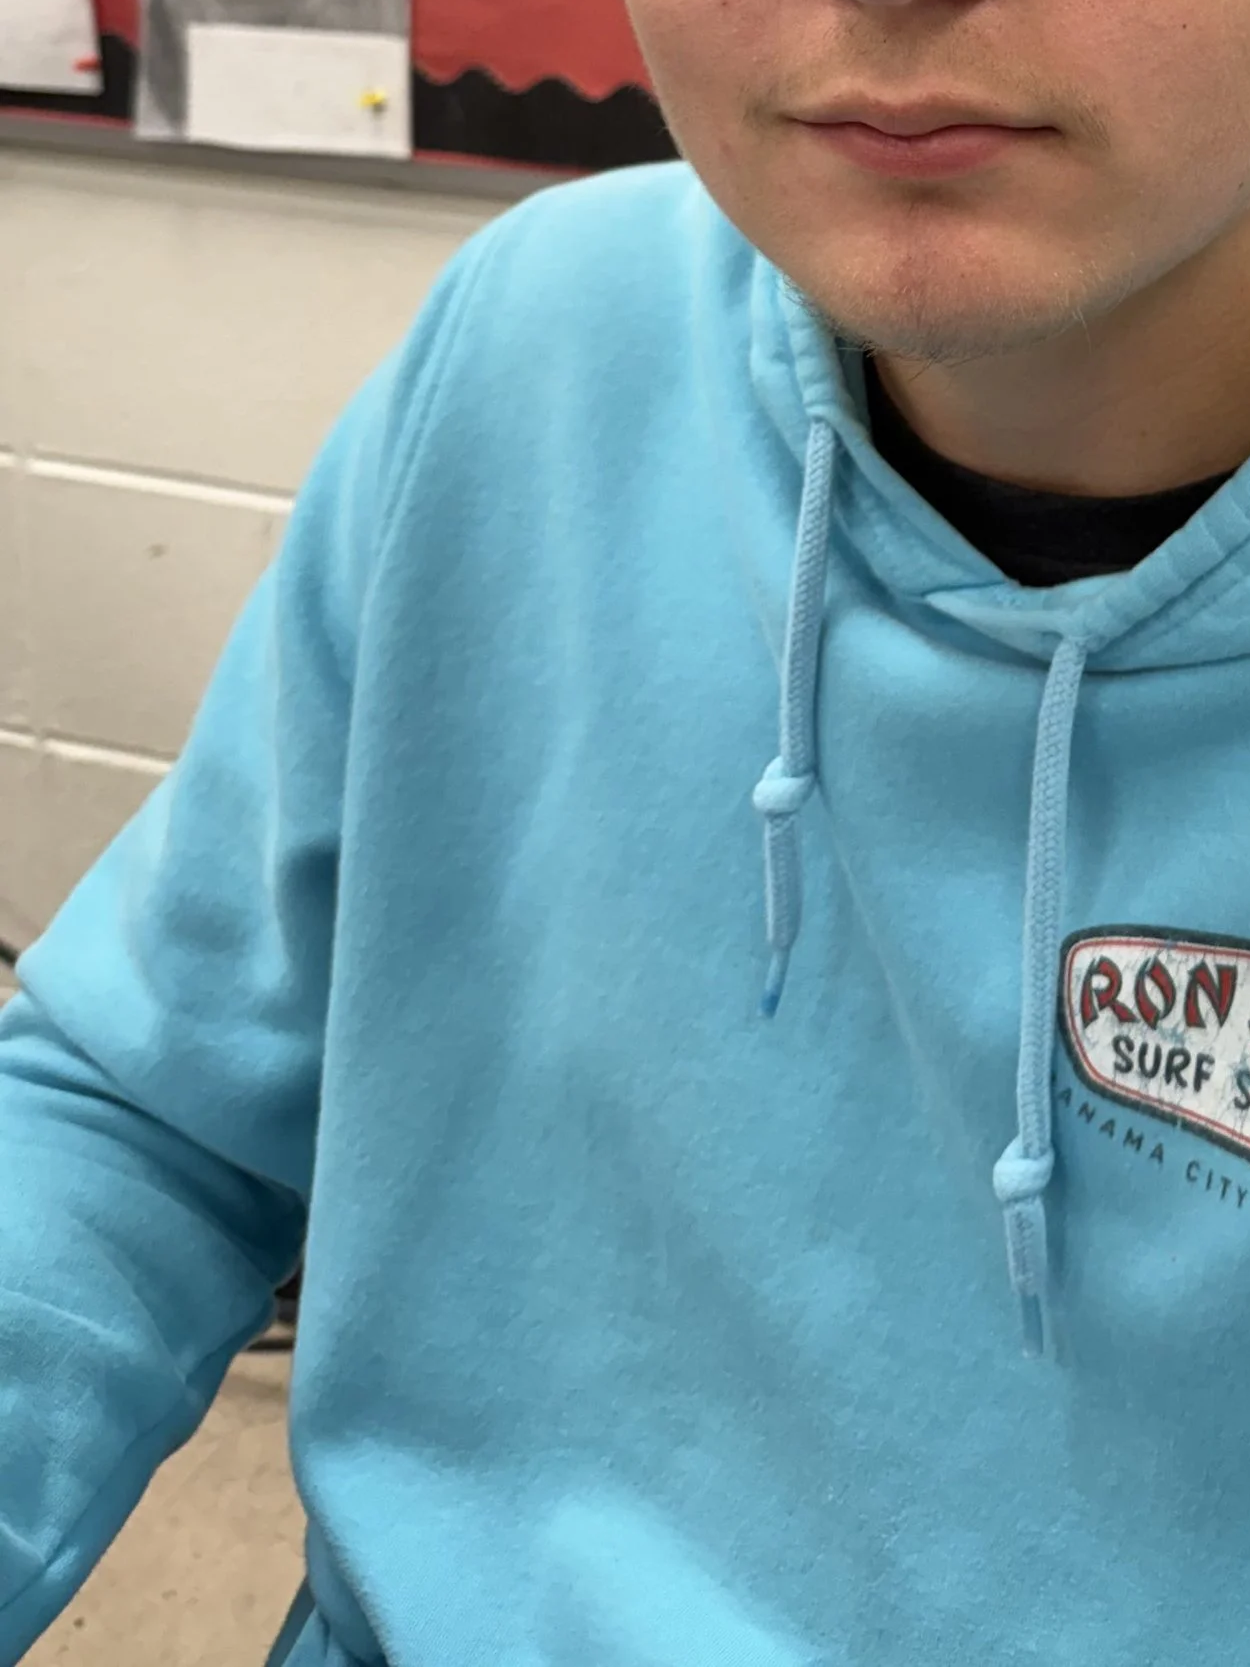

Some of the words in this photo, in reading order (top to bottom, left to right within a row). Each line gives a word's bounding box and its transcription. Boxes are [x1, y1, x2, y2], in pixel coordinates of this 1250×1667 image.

[1081, 955, 1238, 1030] RON
[1112, 1035, 1215, 1091] SURF
[1052, 1072, 1164, 1166] ANAMA
[1186, 1159, 1249, 1209] CITY
